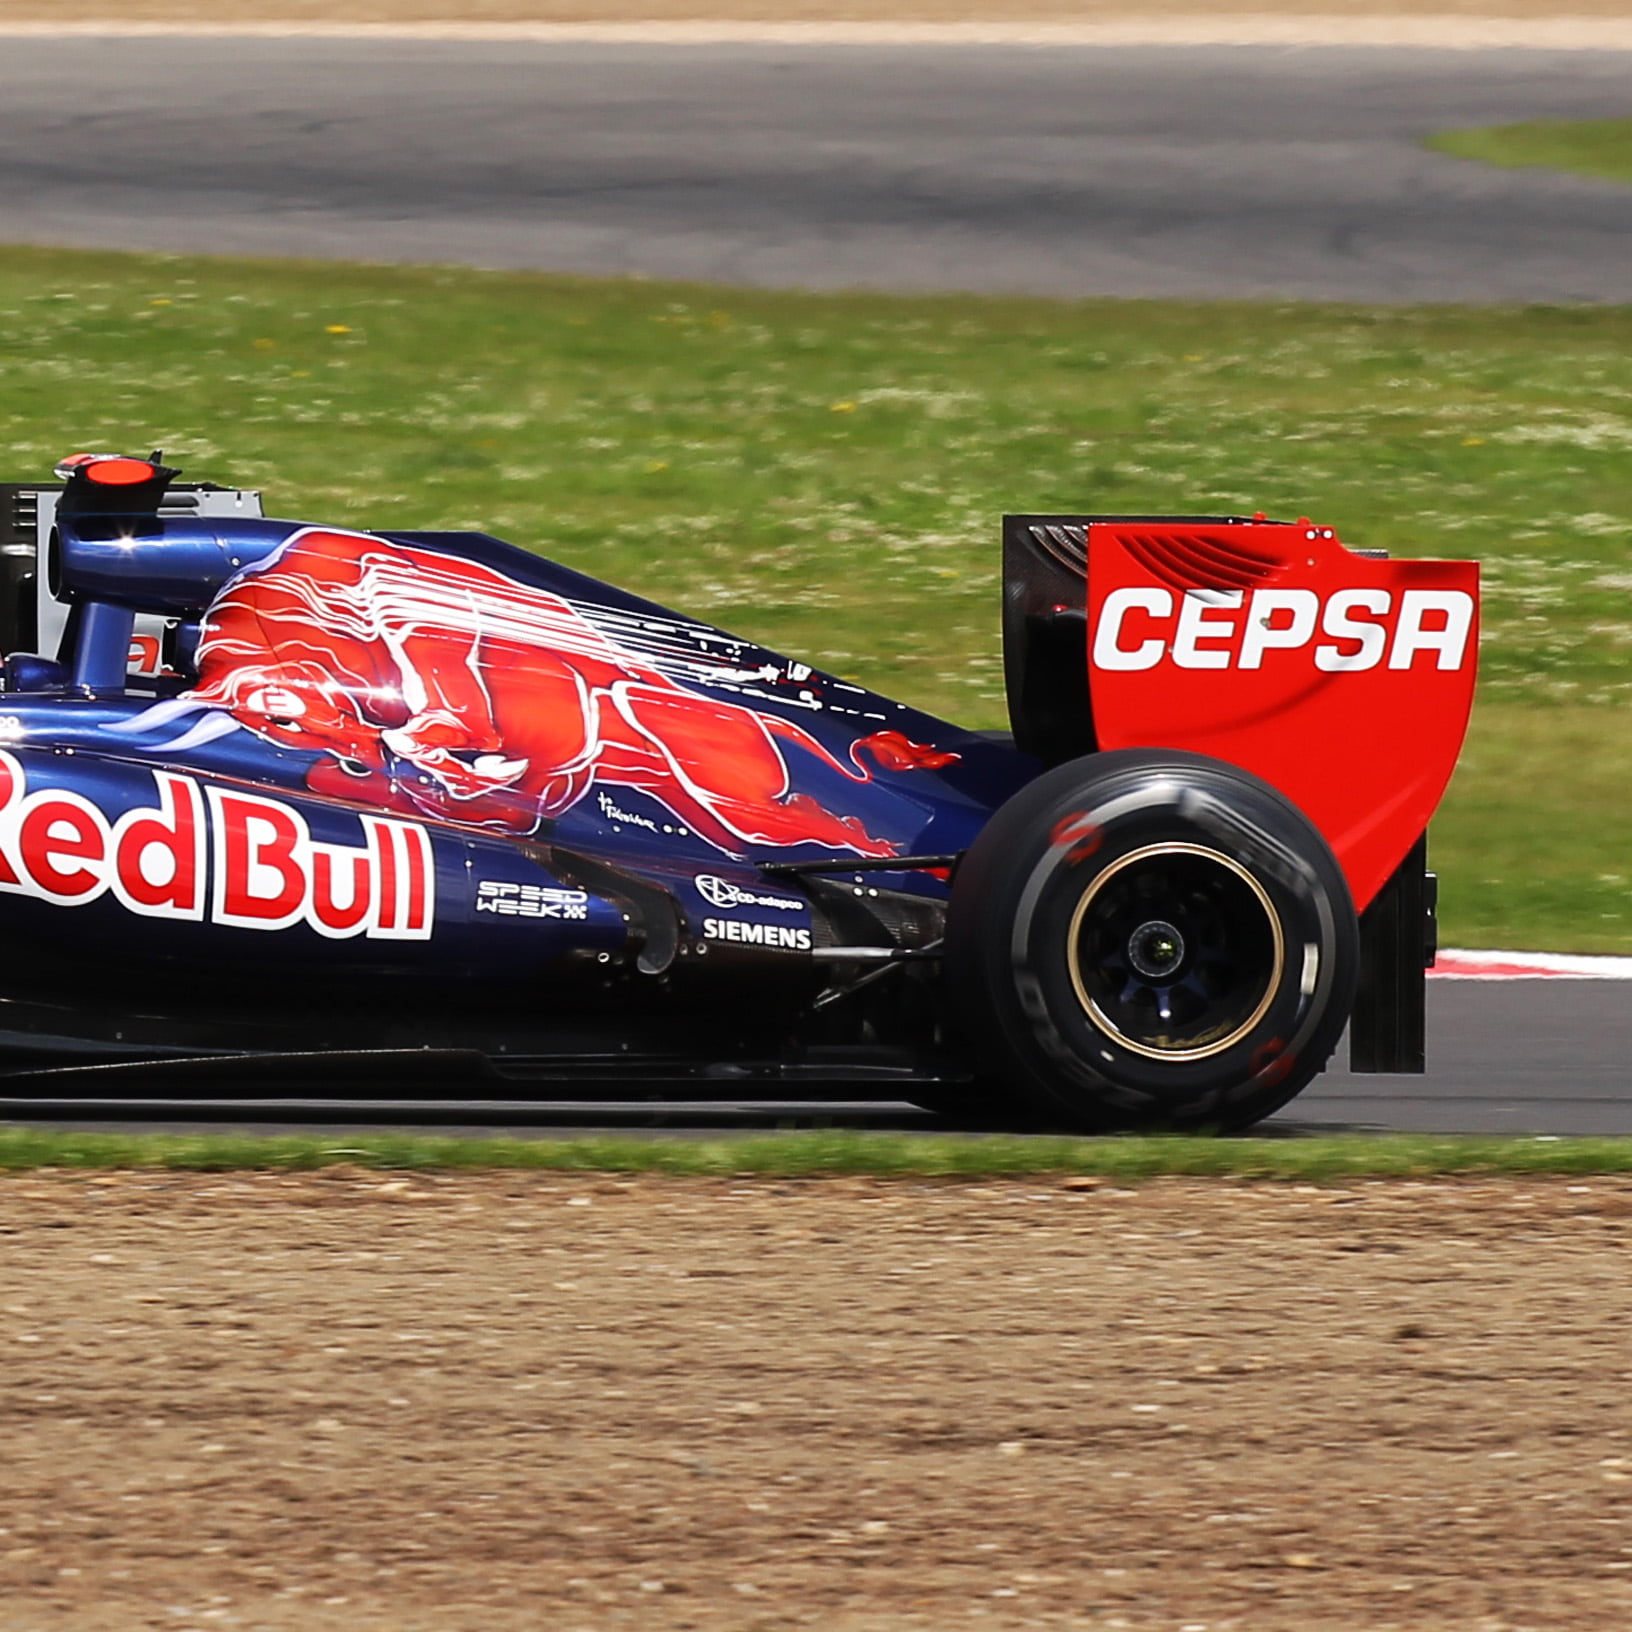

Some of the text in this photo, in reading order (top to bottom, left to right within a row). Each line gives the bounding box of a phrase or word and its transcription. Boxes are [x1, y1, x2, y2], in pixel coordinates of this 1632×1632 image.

[1093, 587, 1474, 671] CEPSA
[478, 880, 588, 904] SPEED
[476, 897, 562, 919] WEEK
[703, 918, 812, 950] SIEMENS
